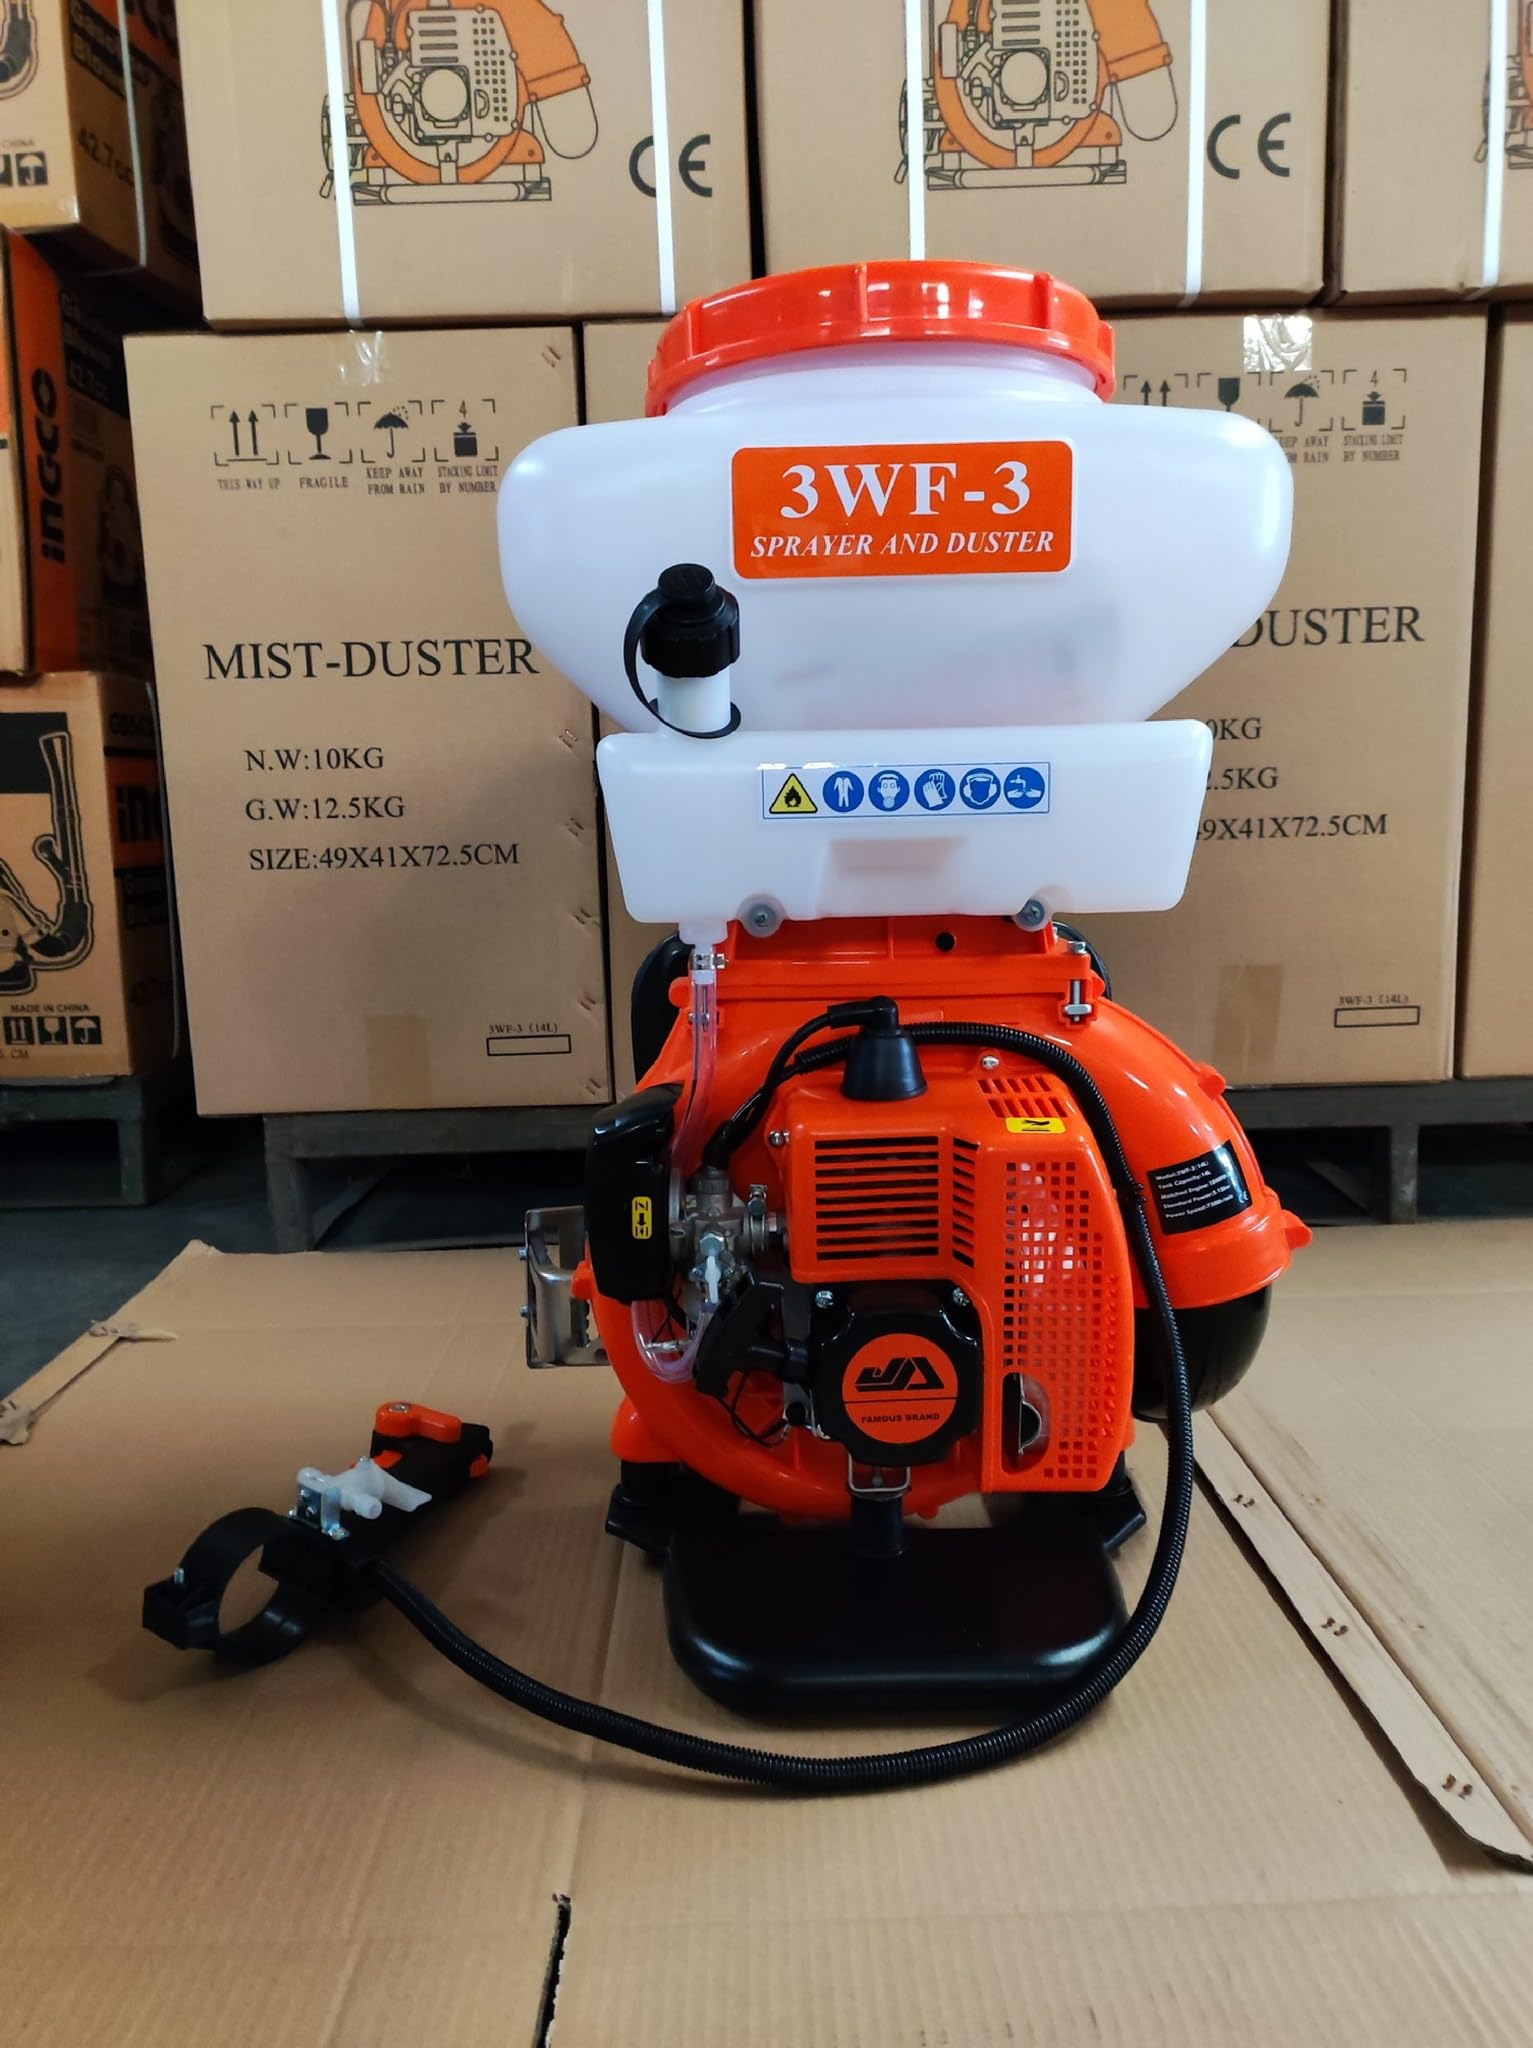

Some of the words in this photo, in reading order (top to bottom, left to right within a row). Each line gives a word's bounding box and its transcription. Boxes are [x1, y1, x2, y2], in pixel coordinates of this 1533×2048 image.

[1206, 112, 1292, 180] CE
[459, 400, 467, 418] 4
[1304, 436, 1329, 447] AWAY
[1303, 451, 1329, 463] RAIN
[1343, 450, 1356, 462] BY
[1361, 449, 1400, 461] NUMBER
[366, 466, 393, 479] KEEP
[399, 466, 424, 478] AWAY
[437, 465, 473, 478] STACKING
[217, 478, 241, 489] THIS
[267, 477, 280, 489] UP
[299, 475, 349, 488] FRAGILE
[439, 482, 452, 494] BY
[458, 481, 497, 493] NUMBER
[367, 483, 394, 495] FROM
[399, 482, 425, 494] RAIN
[779, 460, 1032, 519] 3WF-3
[750, 533, 874, 558] SPRAYER
[880, 532, 939, 556] AND
[946, 530, 1055, 554] DUSTER
[202, 638, 540, 680] MIST-DUSTER
[244, 747, 385, 771] N.W:10KG
[245, 796, 406, 821] G.W:12.5KG
[249, 843, 521, 871] SIZE:49X41X72.5CM
[10, 1004, 41, 1013] MADE
[43, 1003, 54, 1012] IN
[56, 1003, 91, 1012] CHINA
[488, 1023, 524, 1034] 3WF-3
[528, 1022, 558, 1033] (14L)
[861, 1414, 903, 1424] FAMOUS
[905, 1412, 940, 1422] BRAND
